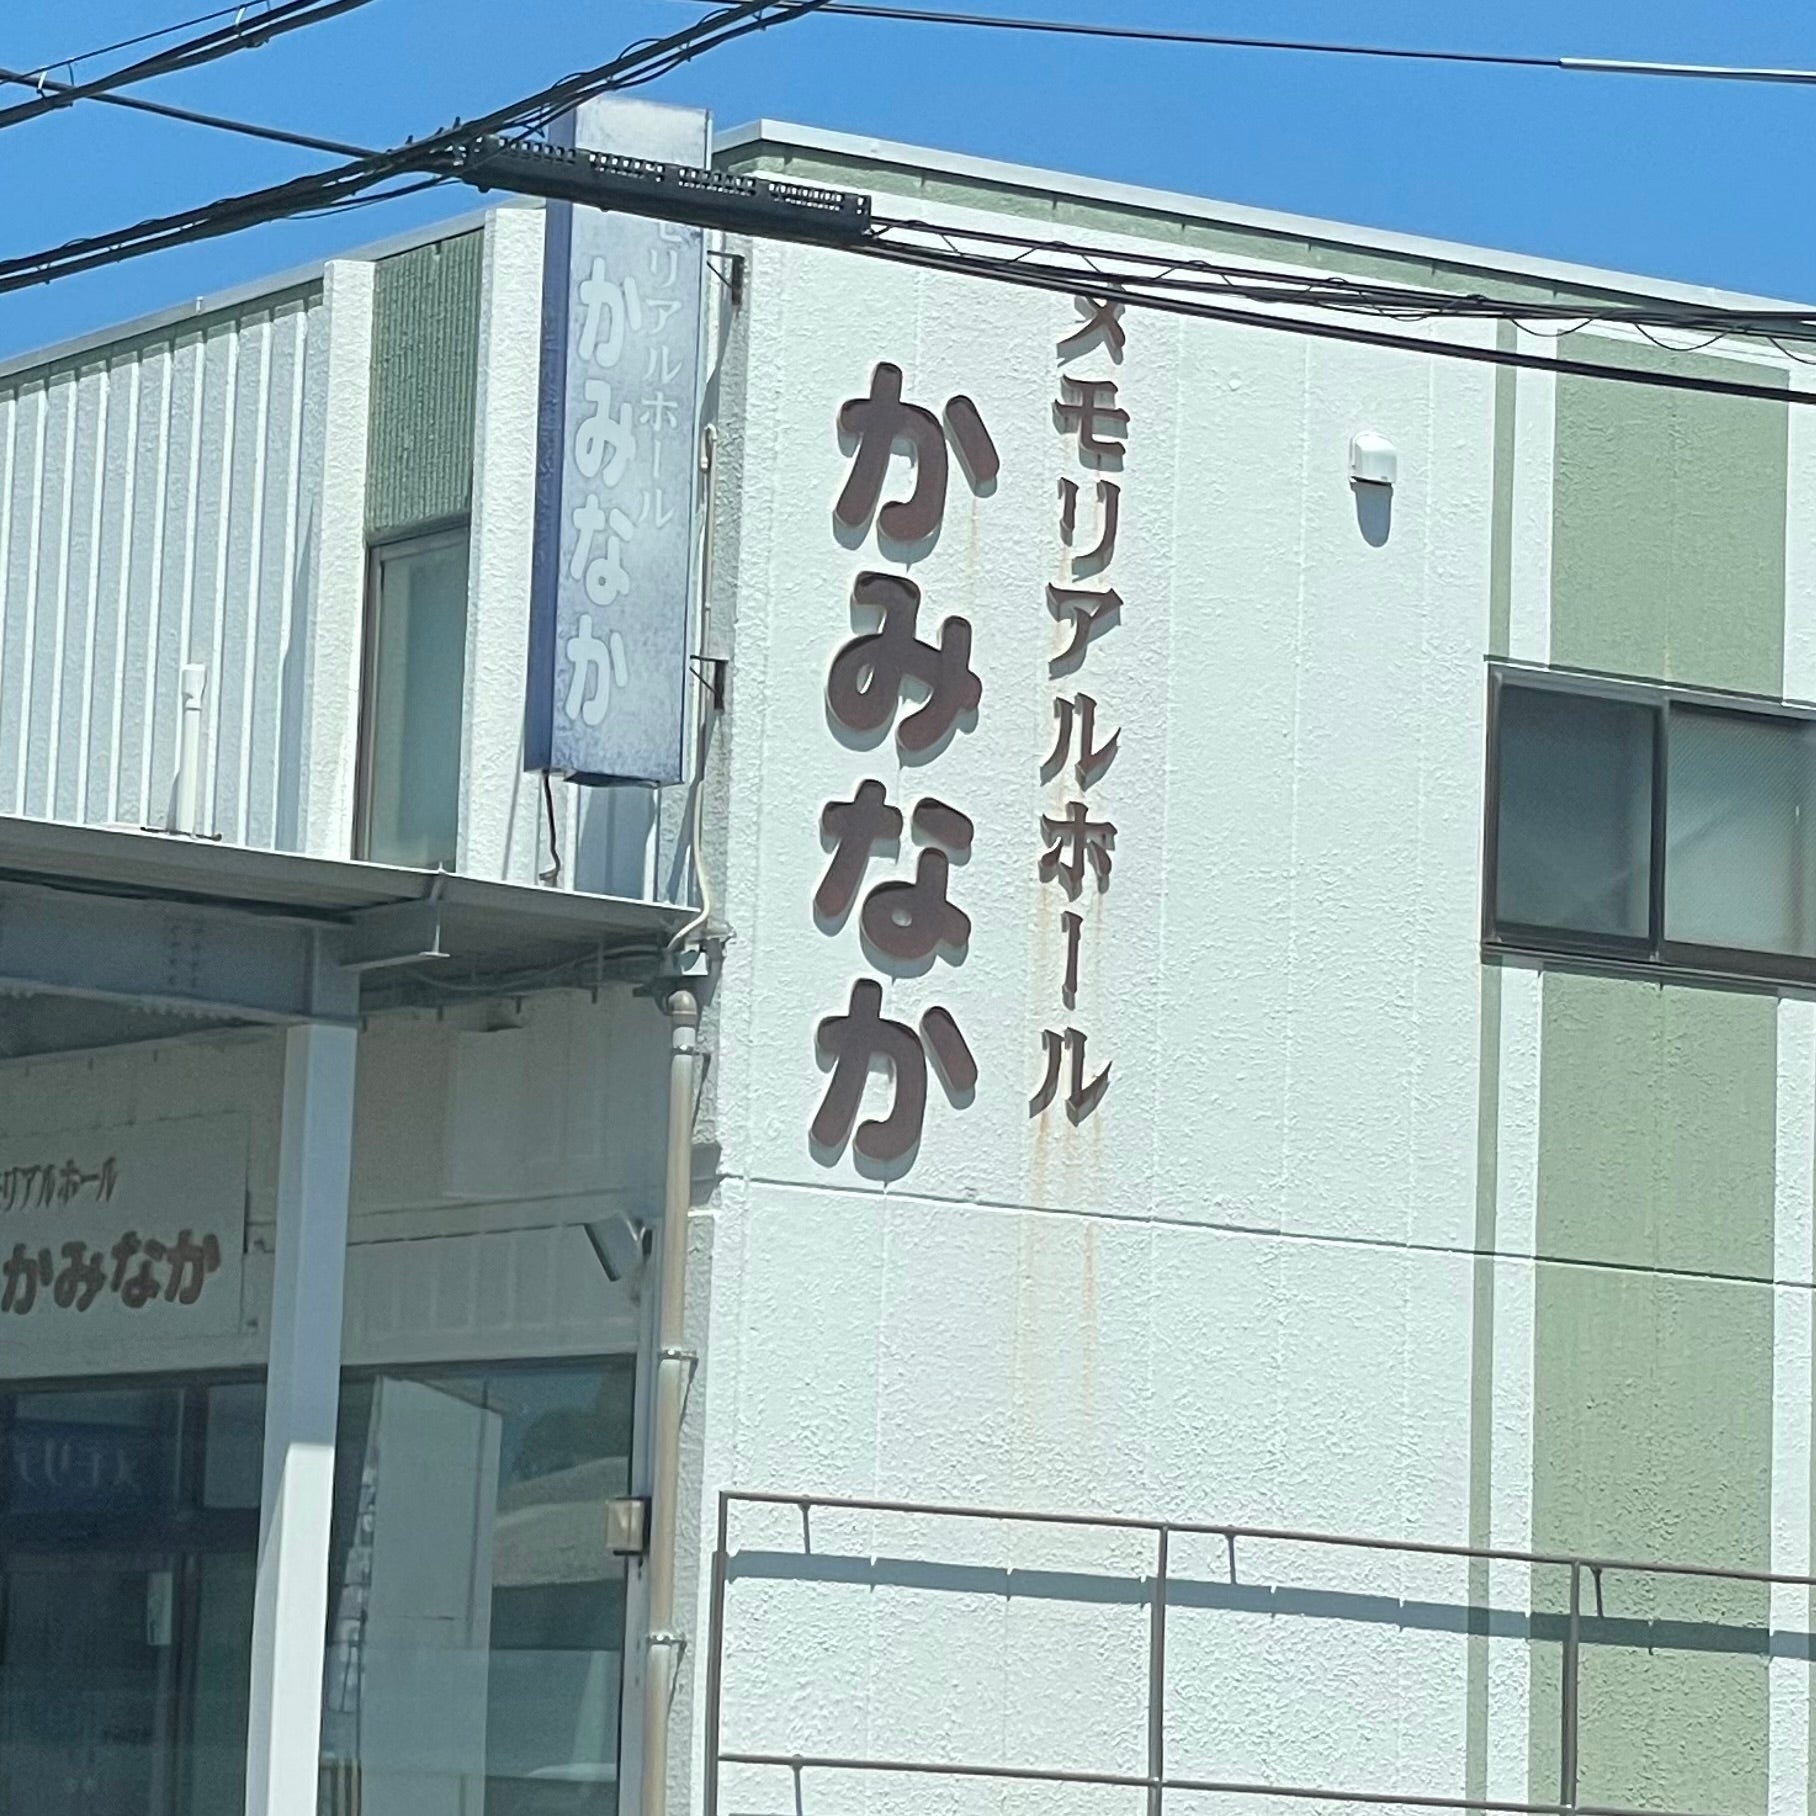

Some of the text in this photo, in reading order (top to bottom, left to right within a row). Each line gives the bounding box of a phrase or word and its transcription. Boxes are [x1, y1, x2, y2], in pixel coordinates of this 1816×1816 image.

[565, 256, 642, 727] かみなか
[1029, 282, 1131, 1126] メモリアルホール
[809, 361, 1000, 1168] かみなか
[0, 1156, 118, 1212] リアルホール
[1, 1229, 221, 1315] かみなか
